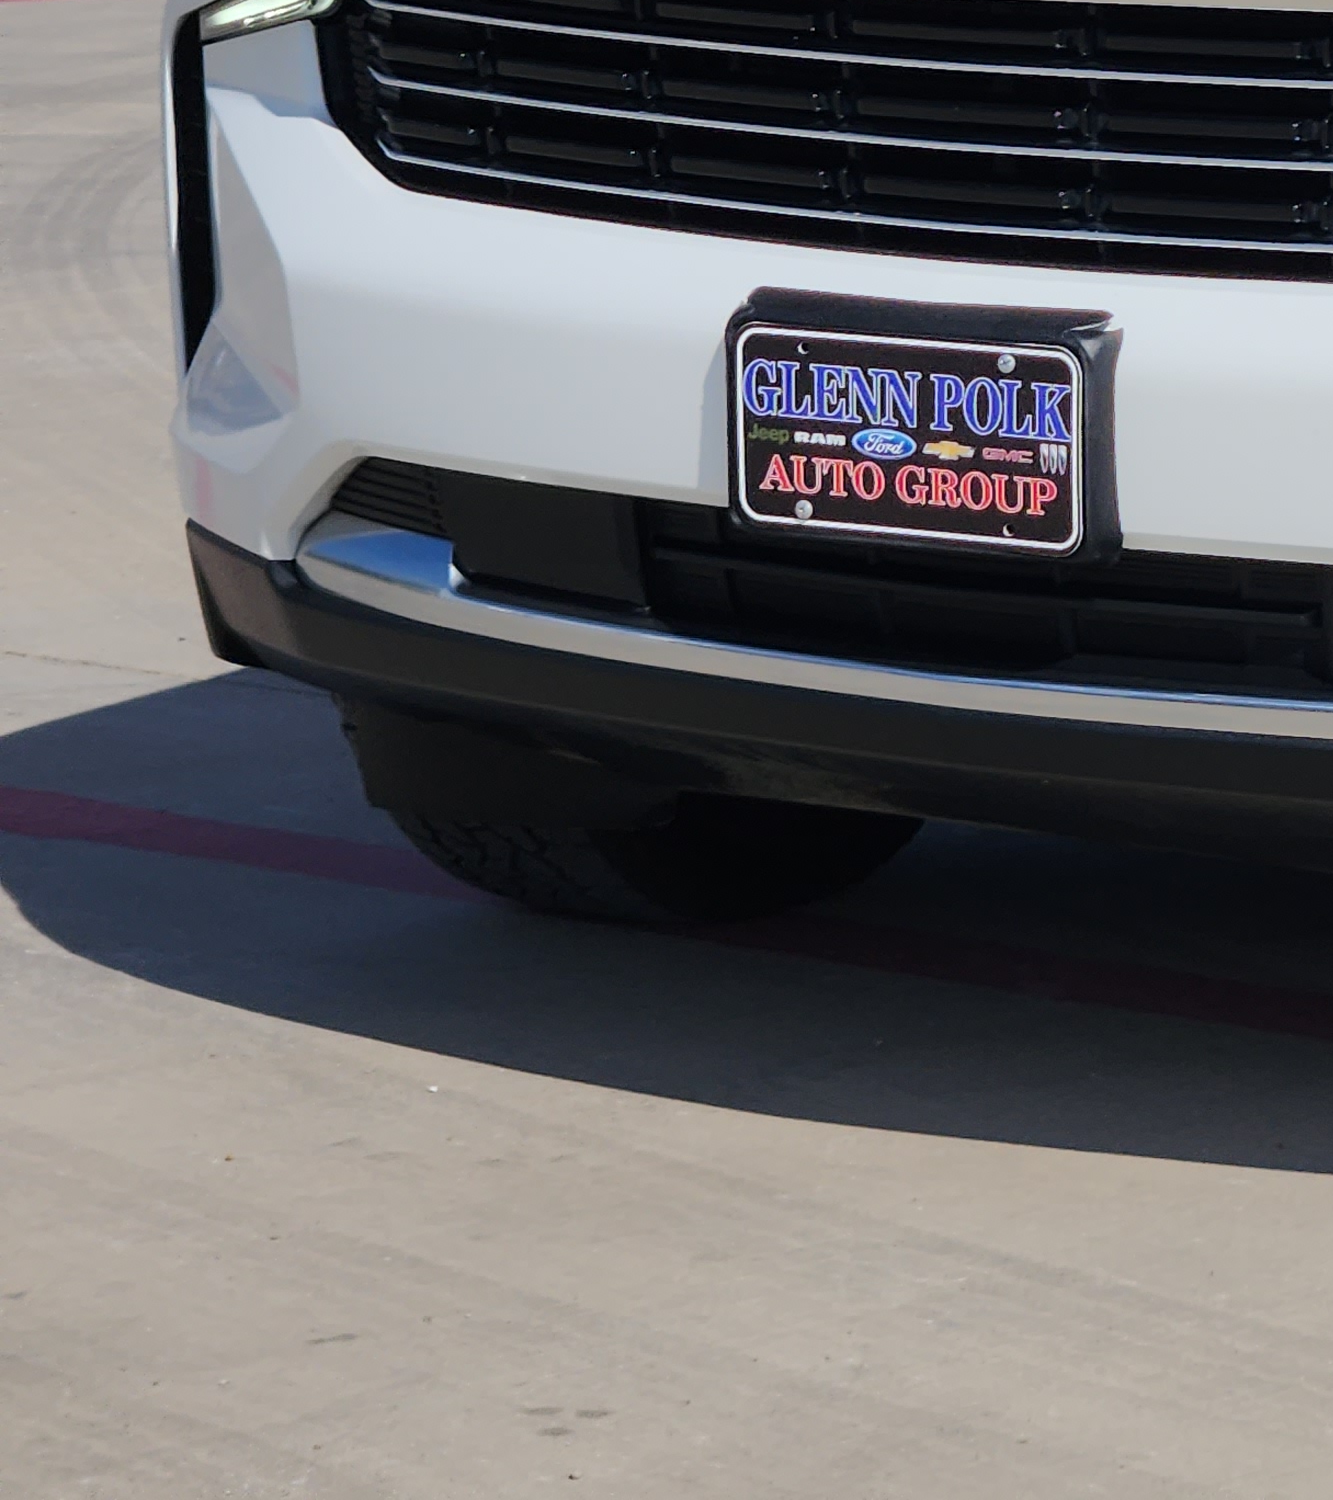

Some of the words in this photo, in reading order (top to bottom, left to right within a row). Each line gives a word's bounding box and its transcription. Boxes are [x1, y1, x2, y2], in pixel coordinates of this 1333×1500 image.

[744, 359, 922, 428] GLENN
[930, 374, 1072, 440] POLK
[748, 423, 788, 445] Jeep
[794, 432, 846, 447] RAM
[983, 448, 1034, 464] GMC
[759, 453, 885, 500] AUTO
[896, 465, 1058, 515] GROUP
